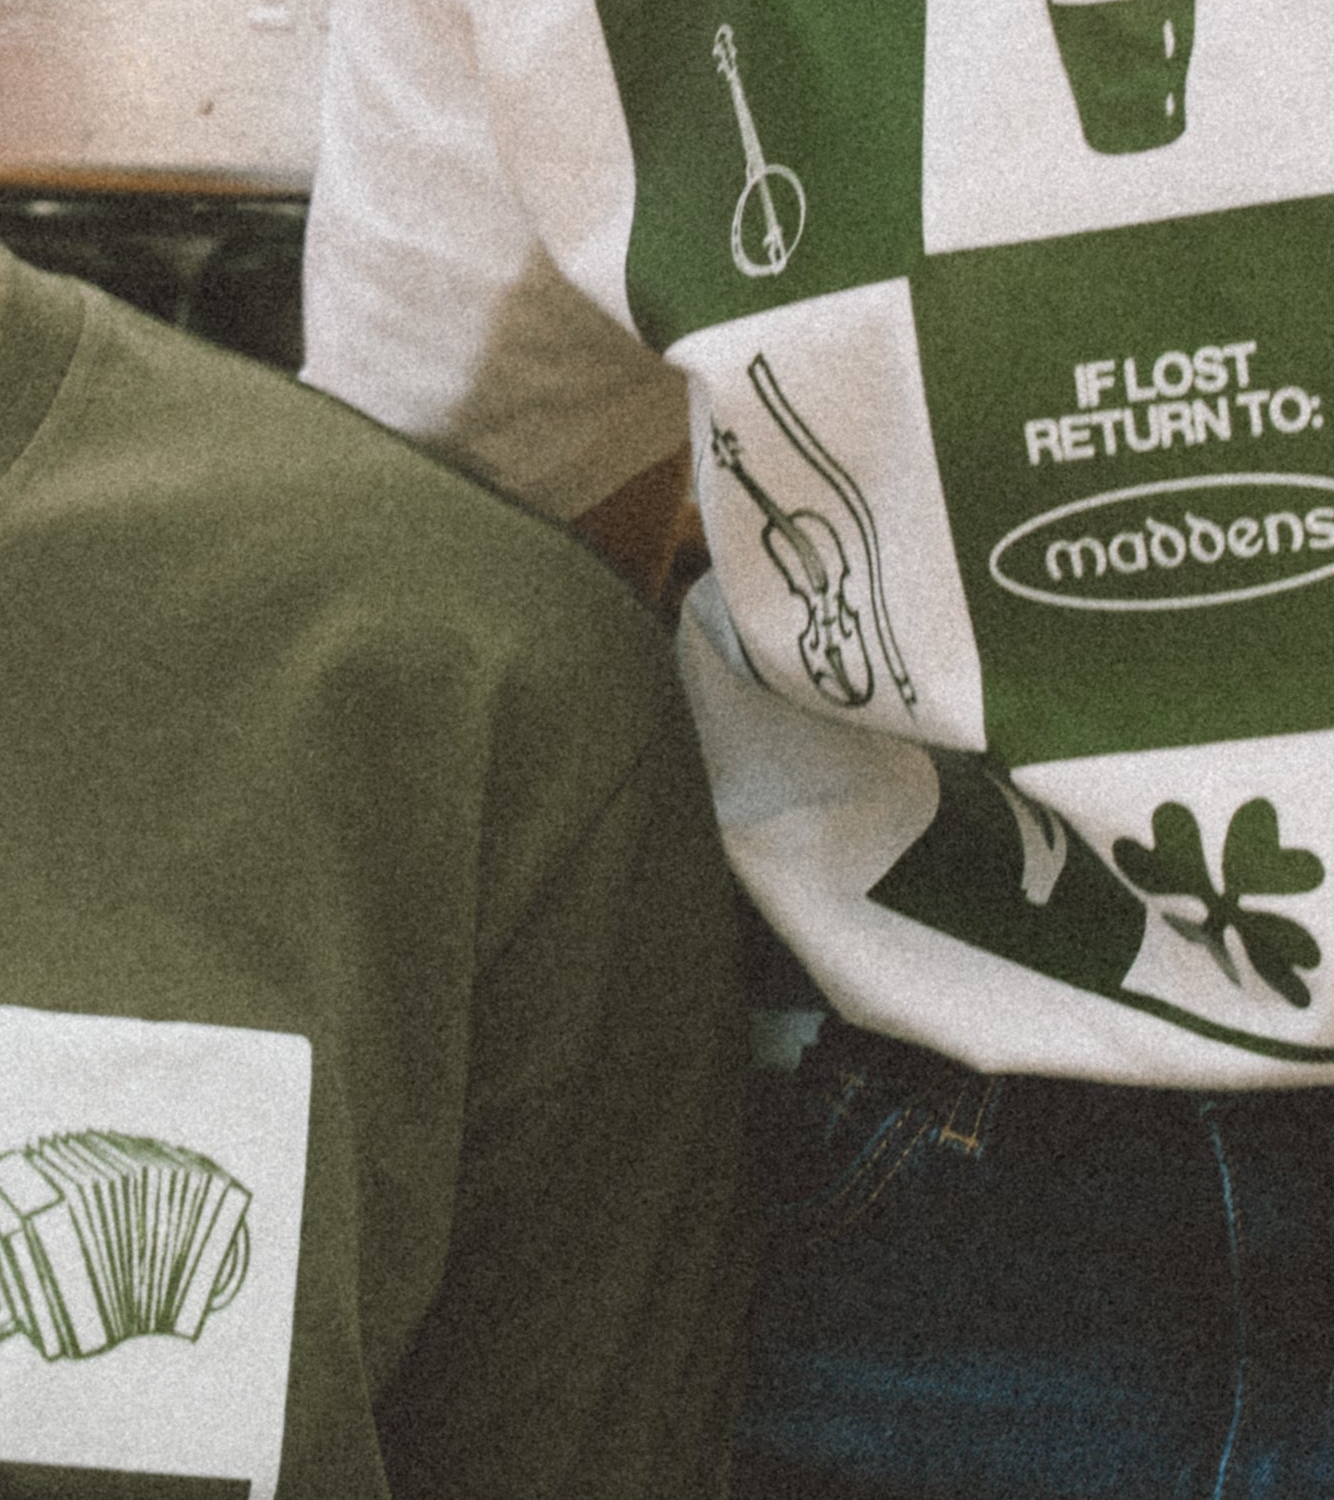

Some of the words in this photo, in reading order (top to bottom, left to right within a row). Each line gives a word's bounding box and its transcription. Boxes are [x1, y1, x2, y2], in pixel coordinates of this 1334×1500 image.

[1074, 358, 1116, 409] IF
[1123, 339, 1257, 402] LOST
[1023, 396, 1232, 466] RETURN
[1235, 385, 1325, 438] TO:
